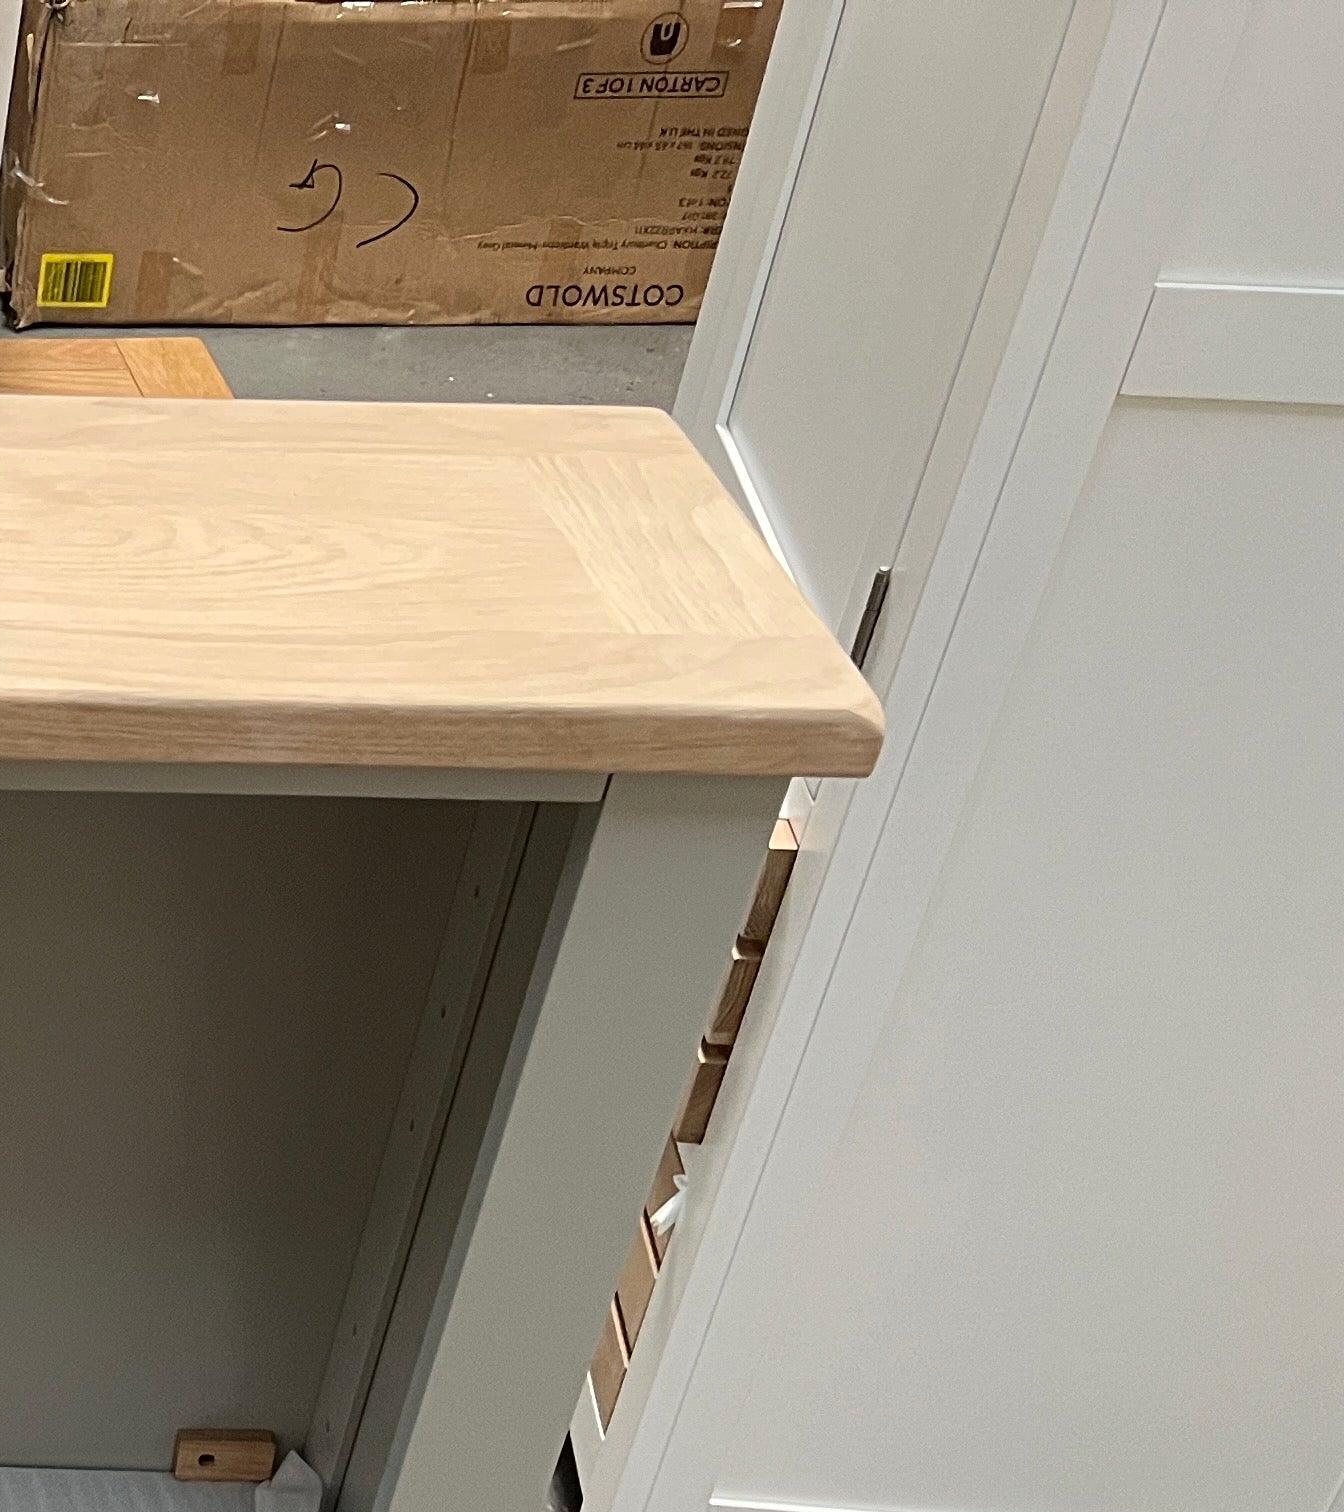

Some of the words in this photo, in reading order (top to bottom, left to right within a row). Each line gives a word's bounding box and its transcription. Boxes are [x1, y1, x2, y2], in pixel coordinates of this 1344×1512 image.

[581, 77, 595, 93] 3
[595, 78, 625, 93] OF
[626, 78, 633, 92] 1
[639, 75, 721, 92] CARTON
[583, 265, 637, 276] COMPANY
[525, 284, 684, 307] COTSWOLD
